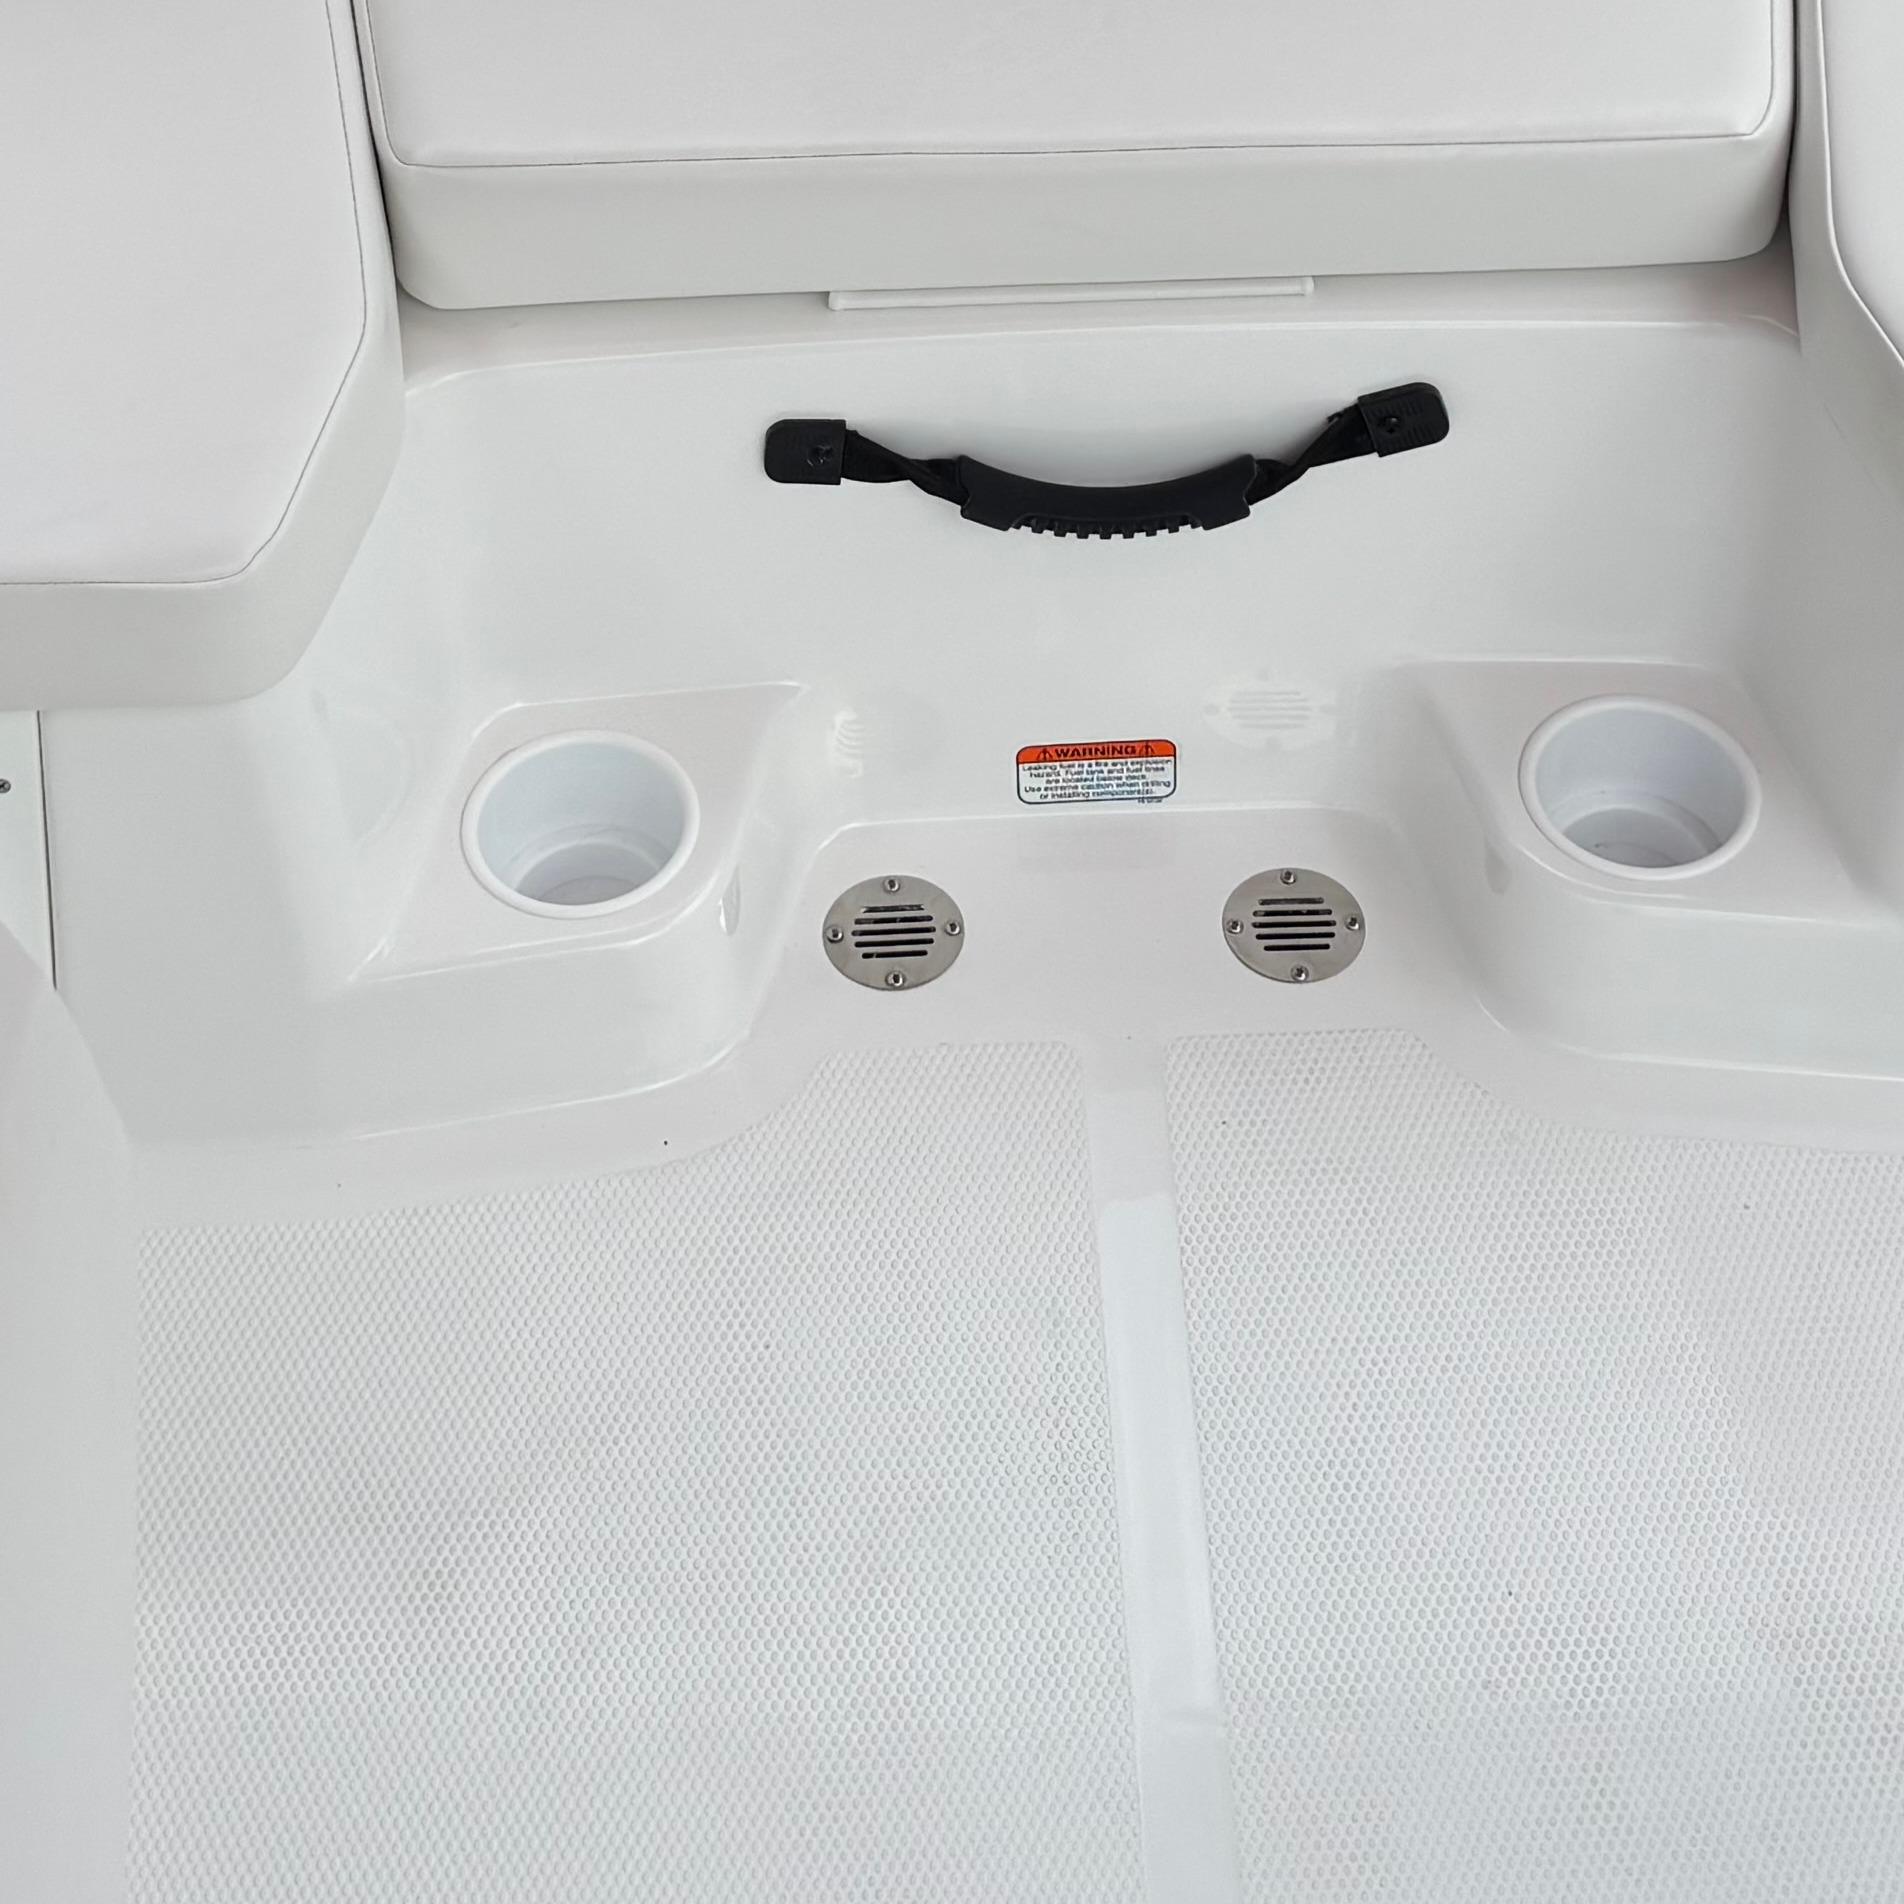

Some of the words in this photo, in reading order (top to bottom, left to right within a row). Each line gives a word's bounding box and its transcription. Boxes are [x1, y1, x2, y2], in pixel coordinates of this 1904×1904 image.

[1054, 745, 1136, 758] WARNING
[1059, 762, 1075, 770] fuel
[1095, 760, 1108, 768] fire
[1131, 759, 1171, 768] explosion
[1065, 768, 1084, 776] Fuel
[1107, 767, 1124, 775] and
[1062, 776, 1094, 784] located
[1081, 782, 1113, 790] caution
[1116, 780, 1139, 788] when
[1052, 790, 1090, 800] installing
